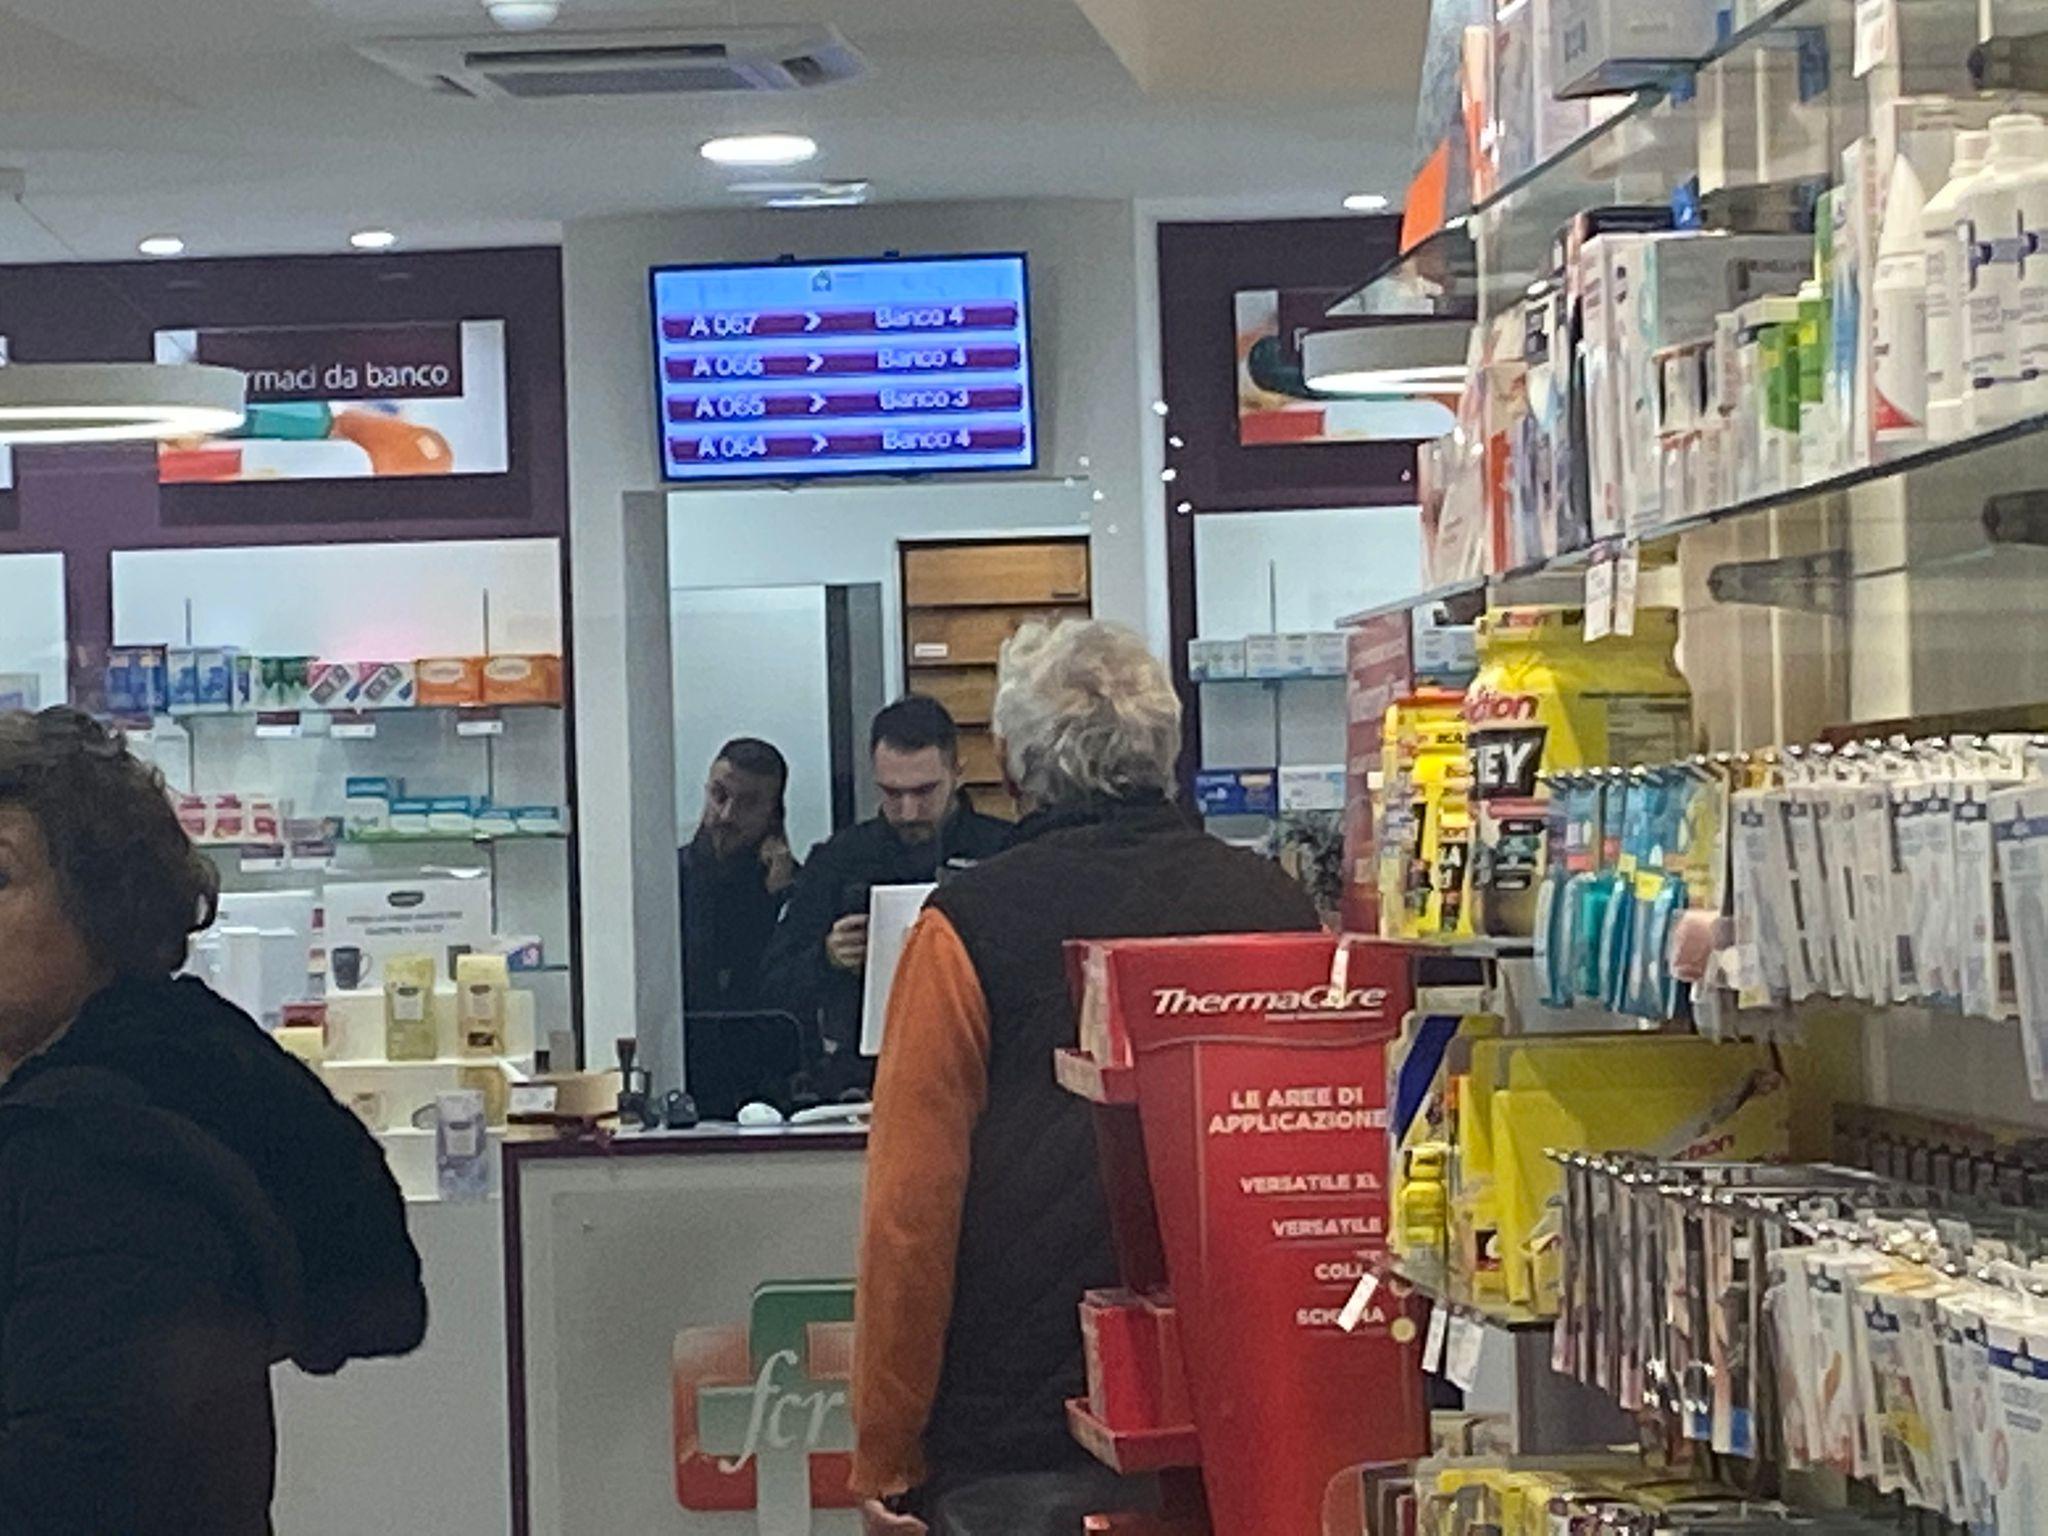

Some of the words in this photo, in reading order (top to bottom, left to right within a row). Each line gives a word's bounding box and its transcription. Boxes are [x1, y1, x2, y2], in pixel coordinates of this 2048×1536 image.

[690, 314, 710, 336] A
[713, 312, 760, 335] 067
[874, 306, 946, 329] Banco
[949, 304, 965, 324] 4
[324, 363, 358, 389] da
[366, 362, 449, 388] banco
[693, 354, 711, 376] A
[714, 354, 764, 377] 066
[877, 348, 948, 369] Banco
[951, 346, 967, 366] 4
[695, 395, 715, 418] A
[879, 387, 950, 410] Banco
[951, 386, 969, 407] 3
[698, 435, 717, 457] A
[720, 435, 768, 458] 064
[882, 429, 952, 450] Banco
[954, 427, 971, 447] 4
[1153, 985, 1388, 1015] ThermaCre
[1231, 1090, 1260, 1110] LE
[1267, 1087, 1332, 1108] AREE
[1338, 1086, 1364, 1105] DI
[1208, 1108, 1388, 1134] APPLICAZIONE
[1240, 1174, 1351, 1194] VERSATILE
[1356, 1172, 1381, 1189] XL
[1272, 1217, 1382, 1237] VERSATILE
[718, 1350, 846, 1474] fcr
